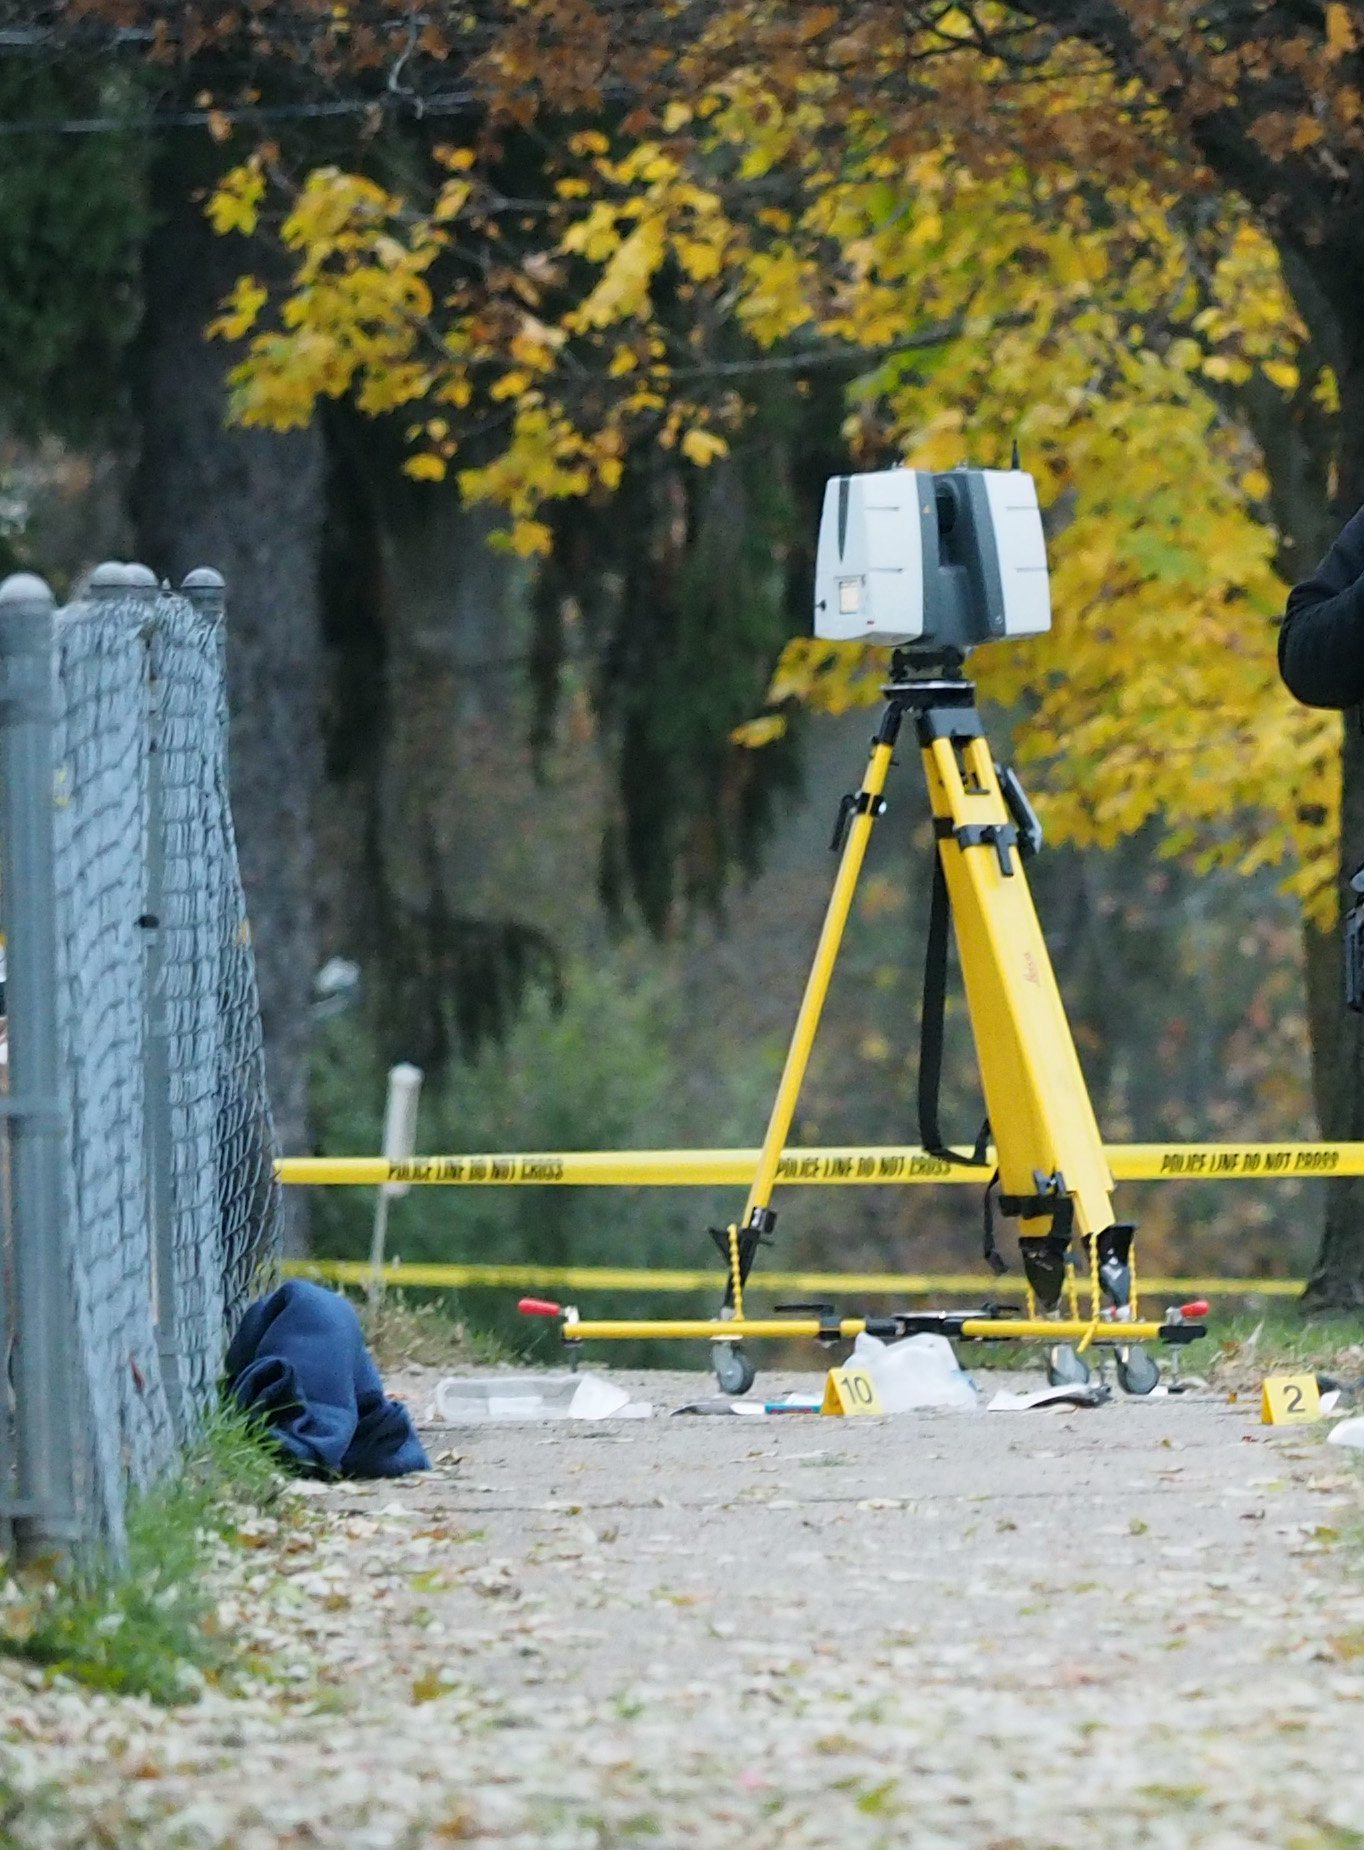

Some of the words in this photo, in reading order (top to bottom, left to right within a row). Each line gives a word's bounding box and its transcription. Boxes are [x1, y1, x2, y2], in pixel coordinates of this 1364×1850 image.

[775, 1157, 819, 1178] POLICE
[823, 1157, 852, 1177] LINE
[879, 1156, 905, 1177] NOT
[1161, 1153, 1206, 1174] POLICE
[1209, 1153, 1239, 1172] LINE
[1241, 1152, 1261, 1172] DO
[1263, 1152, 1292, 1172] NOT
[1294, 1151, 1339, 1171] CROSS
[841, 1376, 873, 1405] 10
[1283, 1385, 1305, 1413] 2
